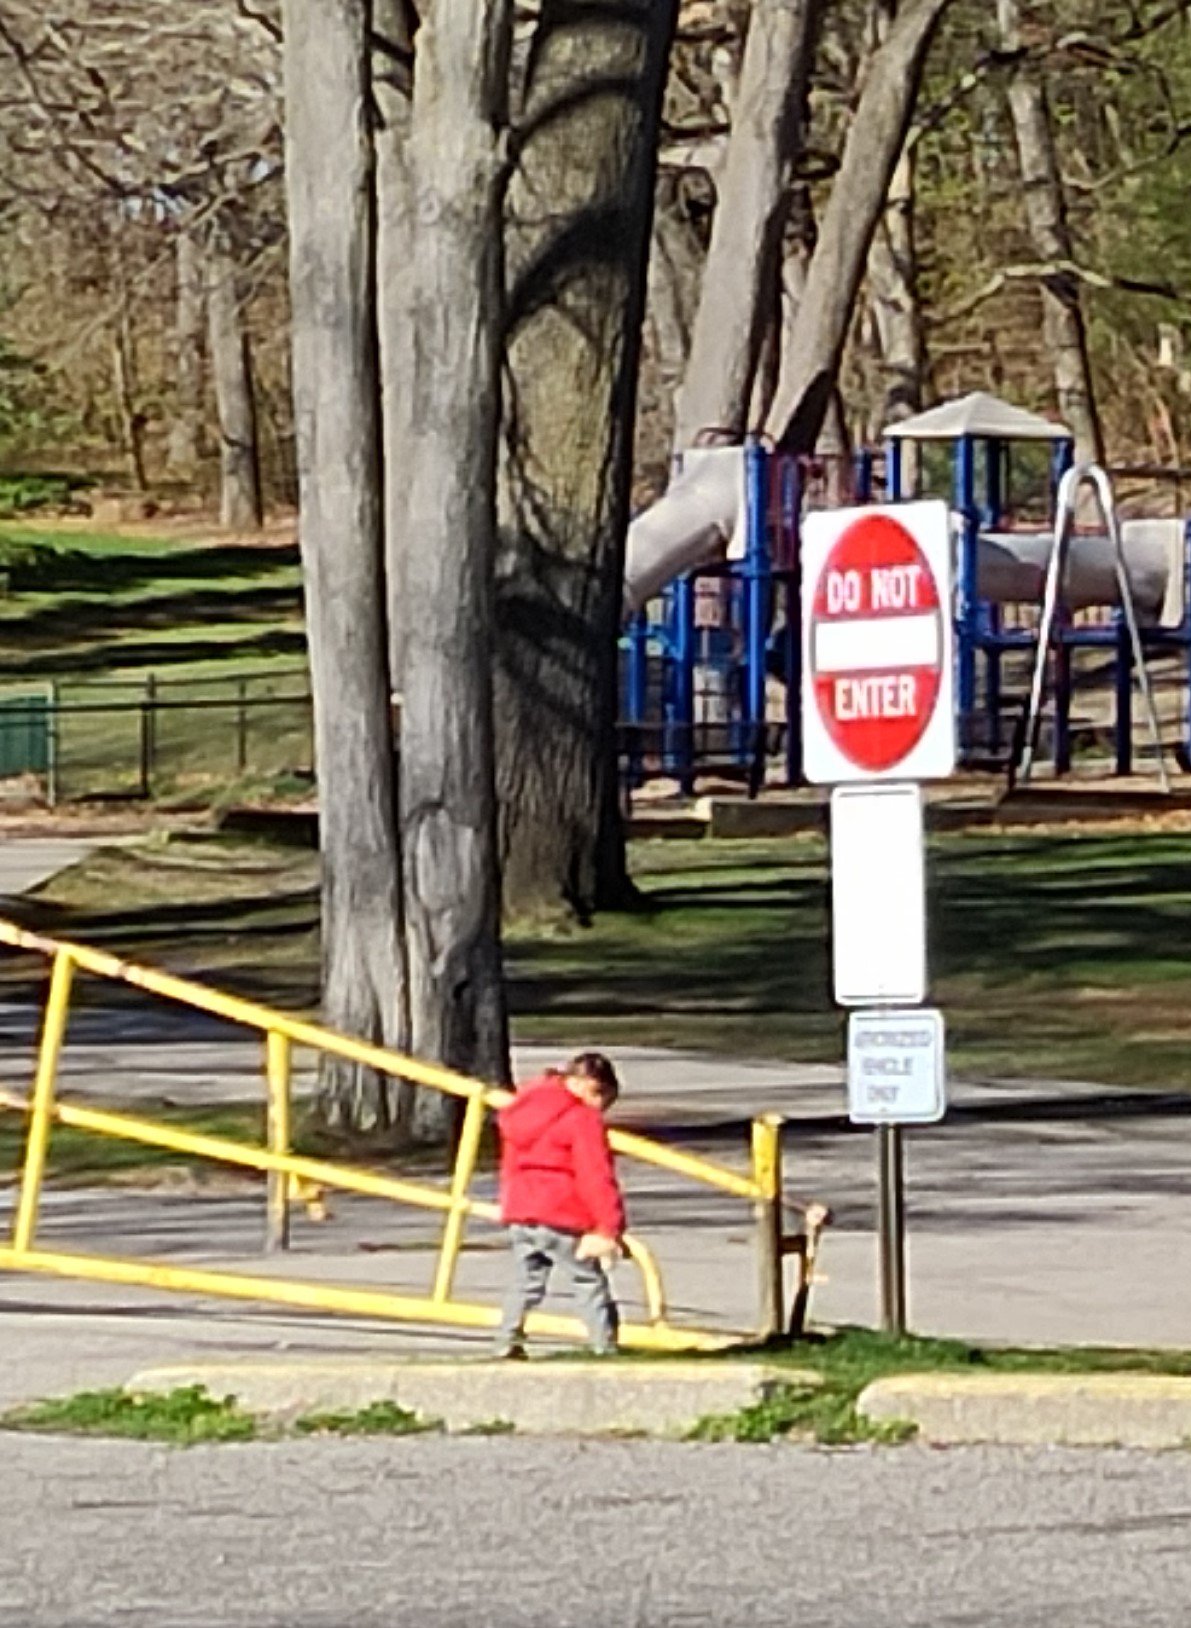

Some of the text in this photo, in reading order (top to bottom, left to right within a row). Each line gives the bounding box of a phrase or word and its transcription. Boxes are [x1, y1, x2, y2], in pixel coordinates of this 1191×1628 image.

[827, 565, 921, 613] DO NOT
[834, 675, 917, 720] ENTER
